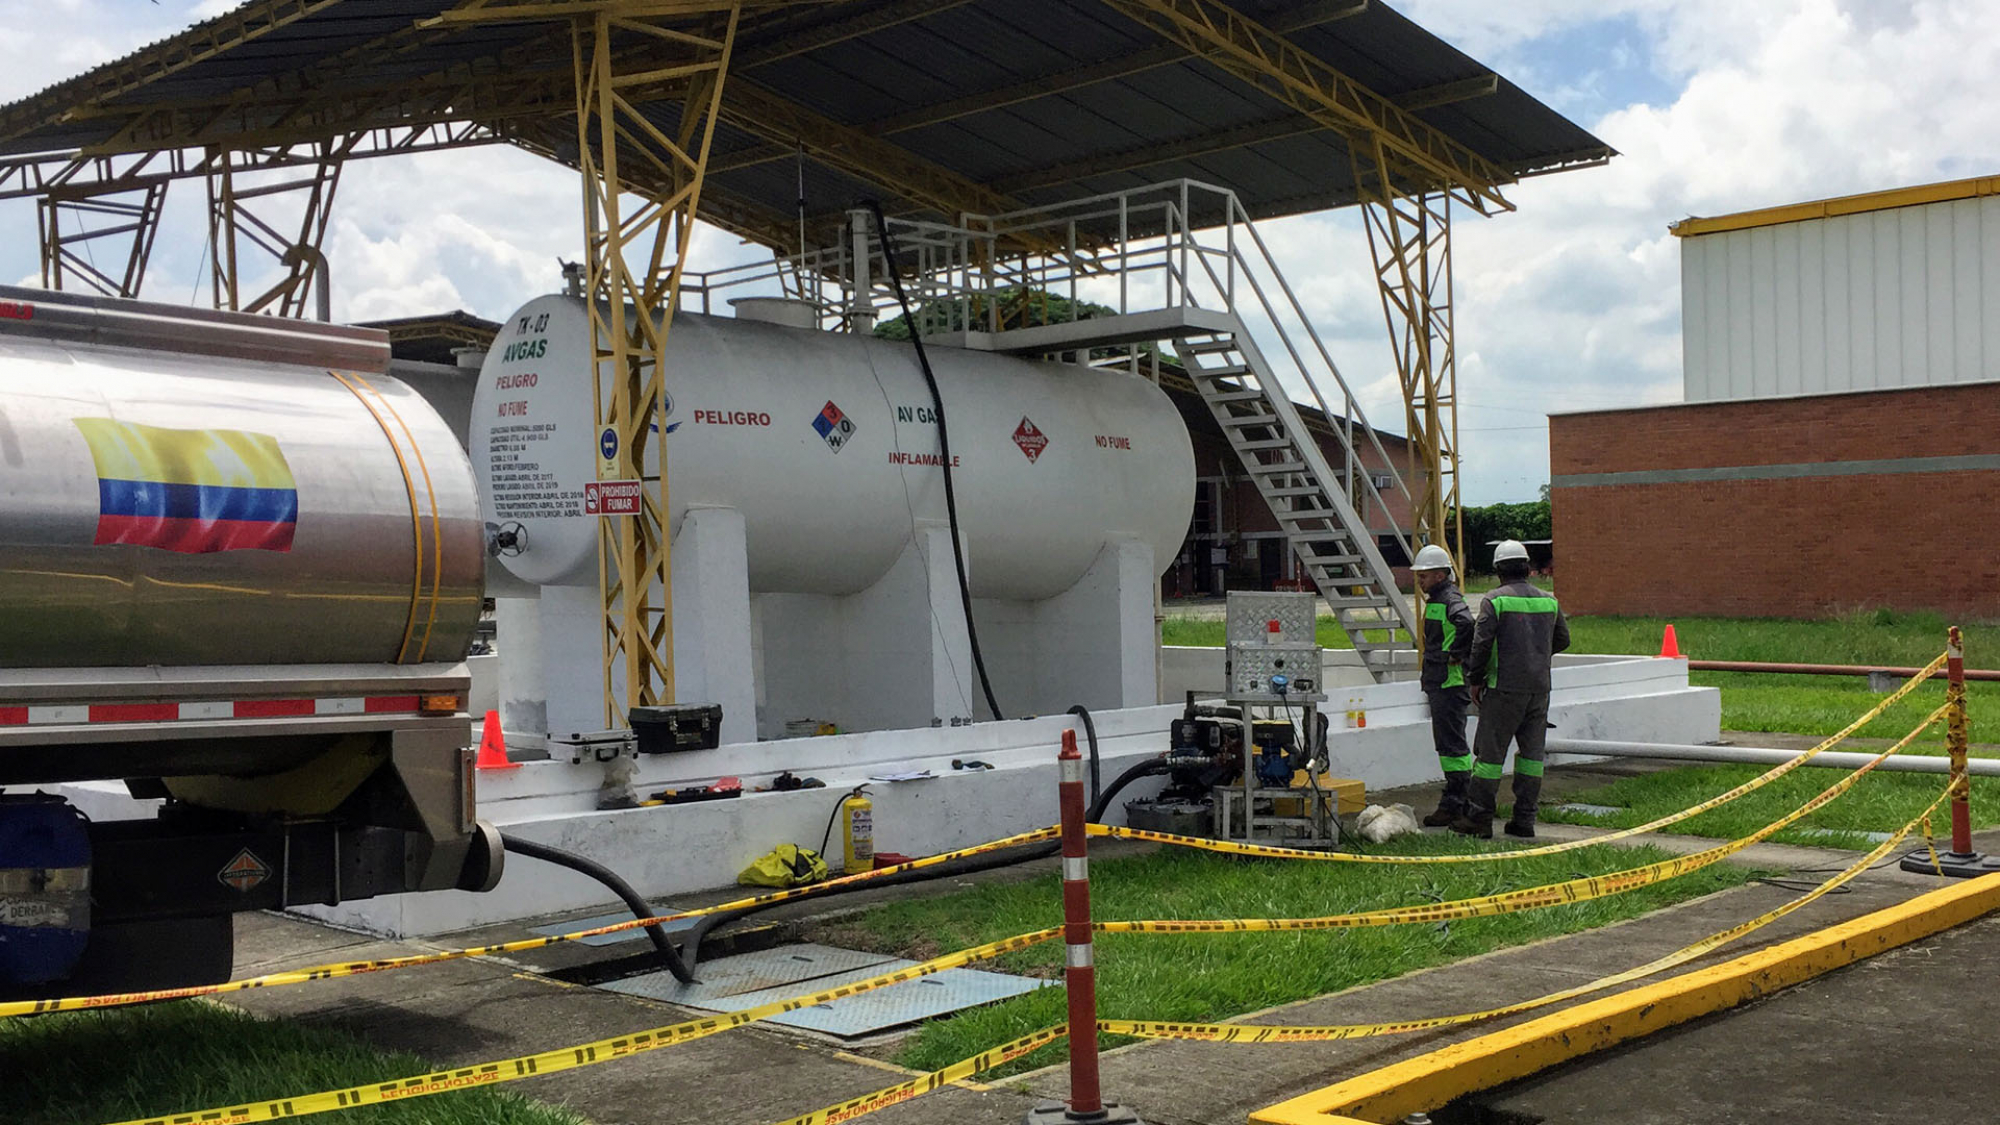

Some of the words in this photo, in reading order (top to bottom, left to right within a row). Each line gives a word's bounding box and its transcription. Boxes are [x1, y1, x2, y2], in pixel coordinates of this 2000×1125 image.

[517, 315, 531, 336] TK
[534, 313, 550, 333] 03
[502, 338, 548, 364] AVGAS
[496, 373, 538, 390] PELIGRO
[498, 402, 507, 417] NO
[508, 400, 528, 416] FUME
[827, 405, 837, 419] 3
[898, 405, 913, 423] AV
[917, 407, 938, 424] GA
[694, 409, 771, 427] PELIGRO
[841, 420, 850, 433] 0
[1095, 434, 1107, 448] NO
[1108, 436, 1131, 450] FUME
[1029, 449, 1036, 460] 3
[601, 485, 639, 497] PROHIBIDO
[608, 498, 633, 510] FUMAR
[870, 1086, 915, 1111] PELIGRO
[853, 1104, 868, 1116] NO
